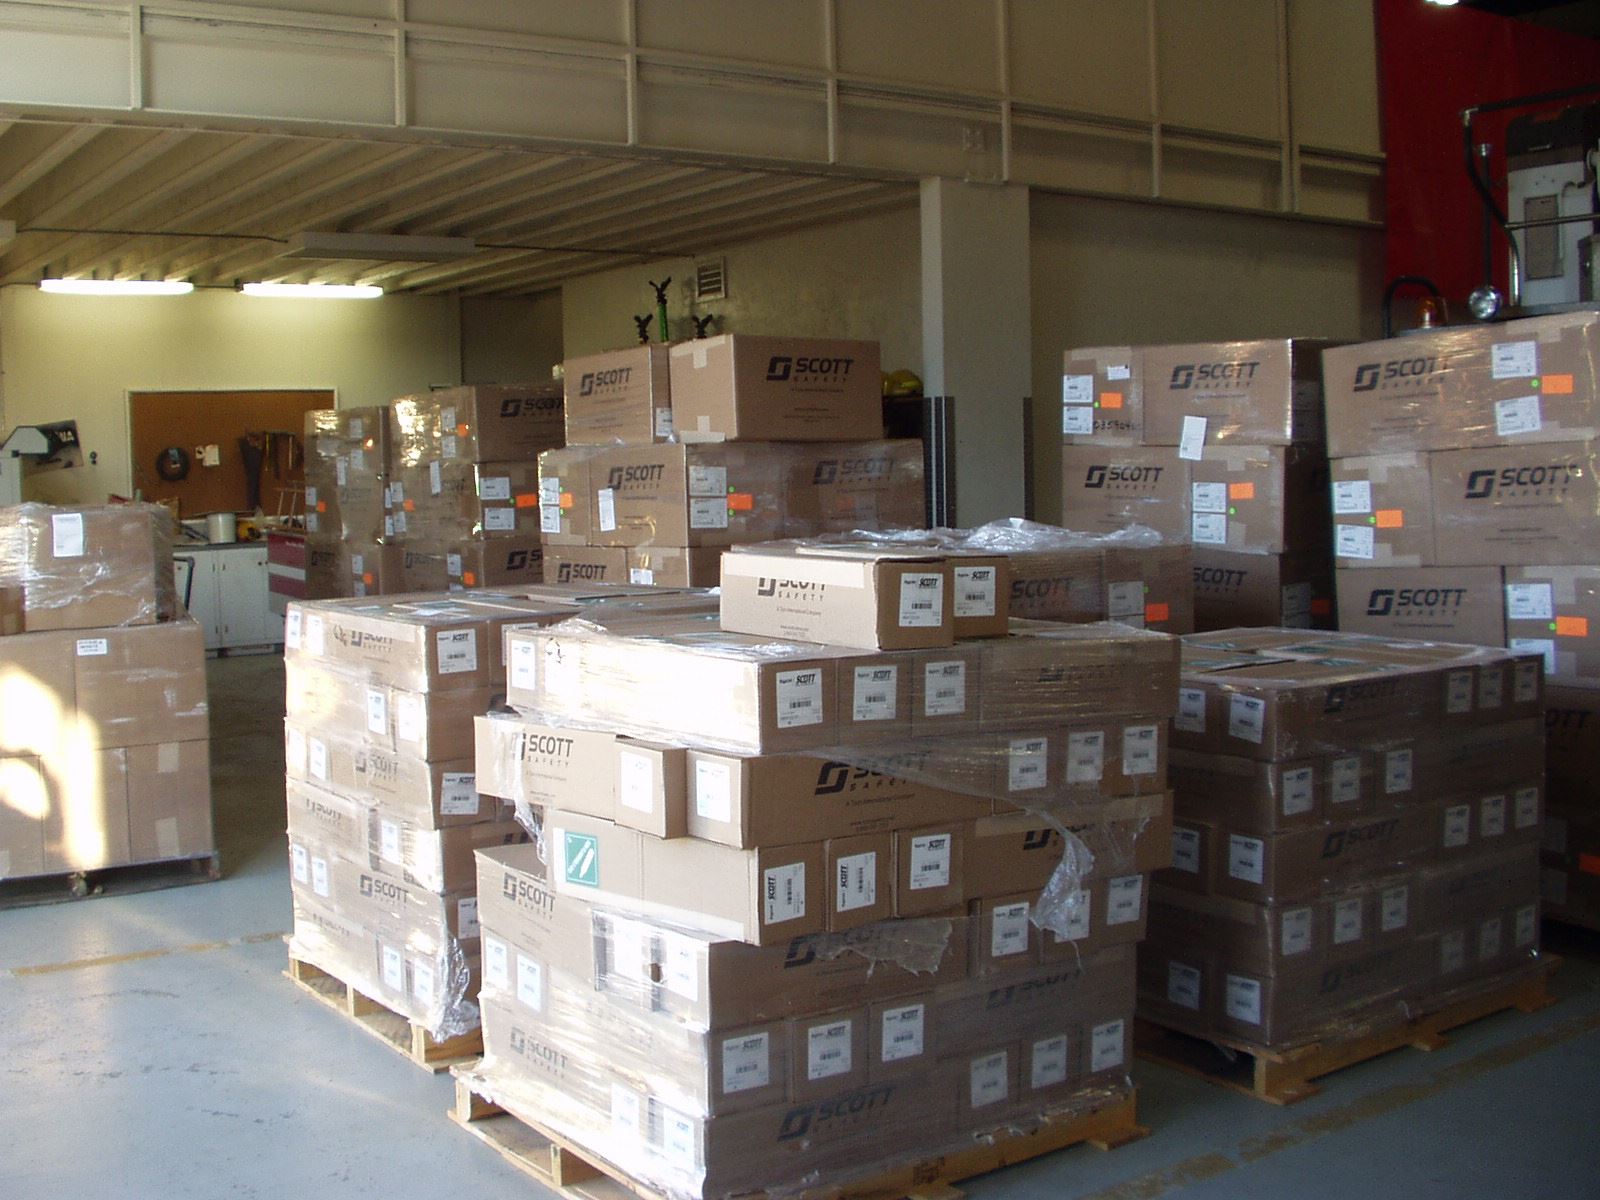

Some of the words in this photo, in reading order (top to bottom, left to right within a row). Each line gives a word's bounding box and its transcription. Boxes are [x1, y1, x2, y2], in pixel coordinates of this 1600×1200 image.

[795, 357, 854, 375] SCOTT
[1196, 362, 1259, 380] SCOTT
[595, 367, 632, 386] SCOTT
[624, 464, 665, 482] SCOTT
[1108, 466, 1164, 482] SCOTT
[1499, 465, 1578, 487] SCOTT
[572, 563, 608, 581] SCOTT
[1010, 576, 1073, 600] SCOTT
[1398, 588, 1467, 607] SCOTT
[796, 674, 815, 686] SCOTT
[529, 734, 573, 758] SCOTT
[374, 879, 409, 904] SCOTT
[519, 880, 556, 912] SCOTT
[768, 877, 777, 900] SCOTT
